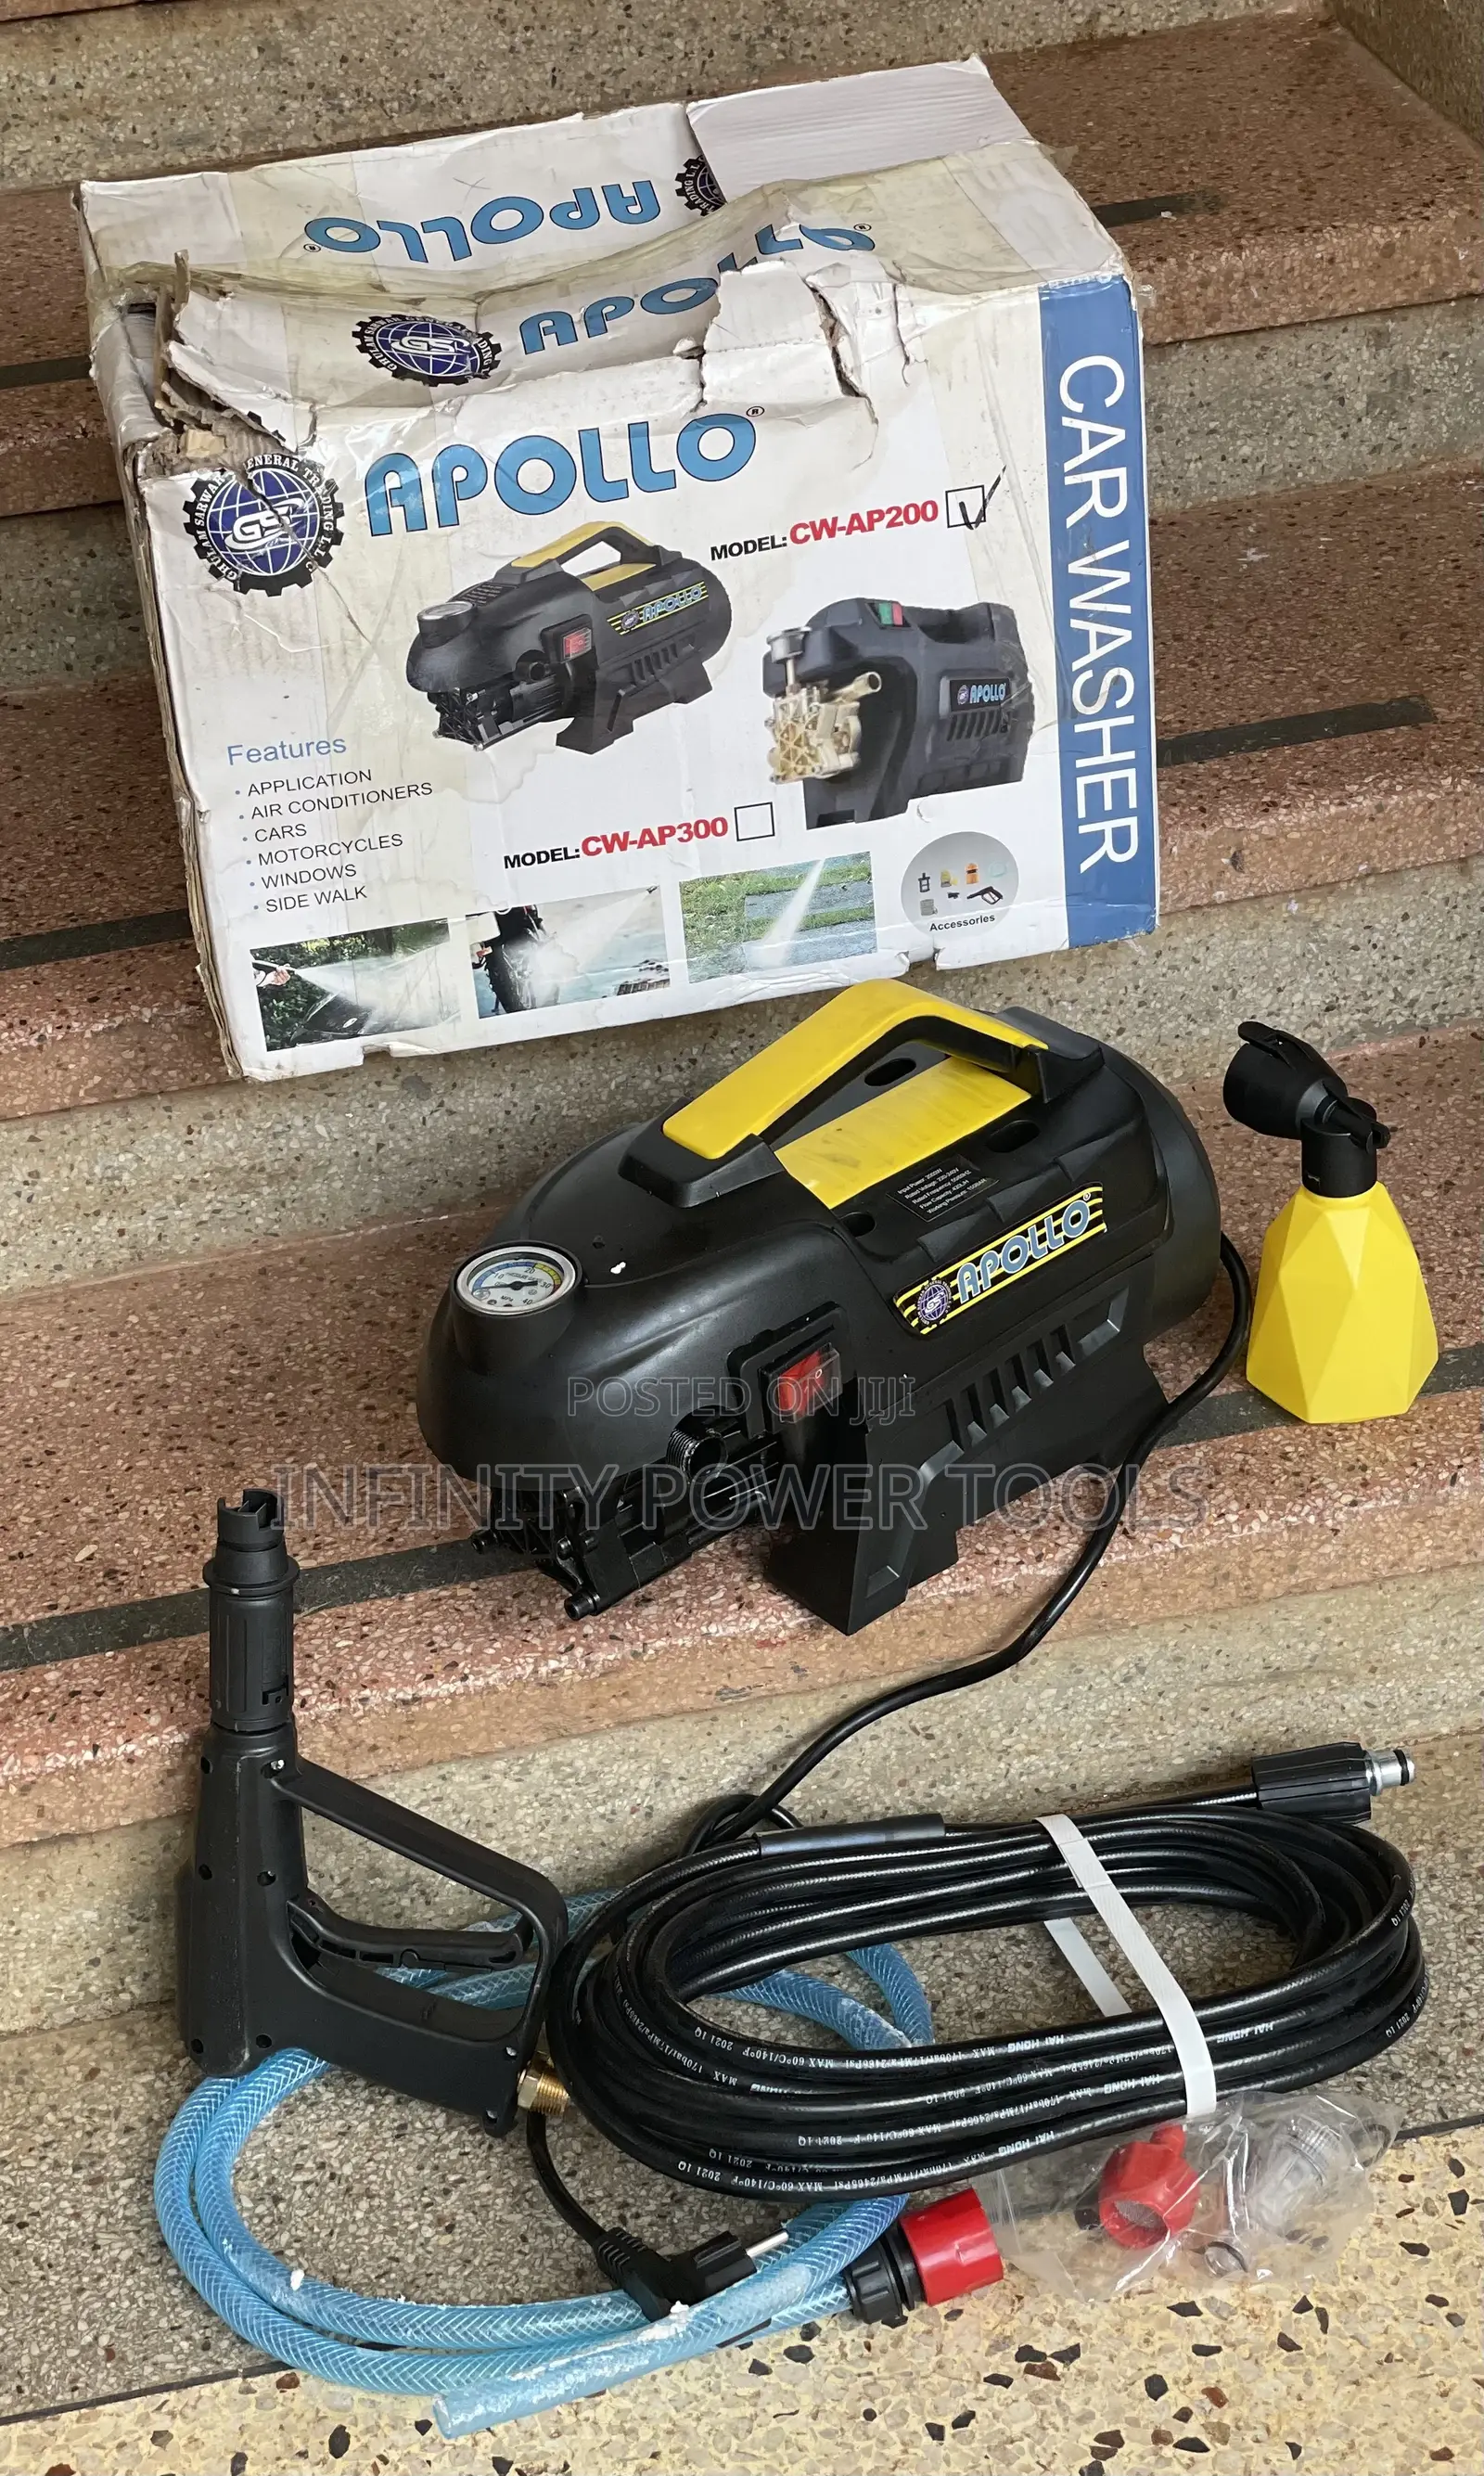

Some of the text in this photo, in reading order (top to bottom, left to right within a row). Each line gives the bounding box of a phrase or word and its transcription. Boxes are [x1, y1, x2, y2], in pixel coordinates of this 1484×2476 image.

[304, 180, 661, 263] APOLLO
[246, 454, 299, 472] ENERAL
[365, 413, 757, 537] APOLLO
[194, 475, 225, 526] SARWAR
[710, 500, 939, 561] MODEL: CW-AP200
[196, 530, 237, 582] GHULAM
[1058, 354, 1139, 873] CAR WASHER
[969, 683, 1006, 704] APOLLO
[227, 737, 347, 765] Features
[247, 769, 373, 797] APPLICATION
[251, 782, 433, 820] AIR CONDITIONERS
[254, 823, 307, 842] CARS
[504, 817, 728, 869] MODEL: CW-AP300
[259, 833, 403, 867] MOTORCYCLES
[262, 864, 357, 890] WINDOWS
[265, 886, 367, 913] SIDE WALK
[928, 914, 996, 932] Accessories
[956, 1200, 1091, 1304] APOLLO
[710, 2034, 734, 2051] 2021
[808, 2057, 835, 2069] MAX
[712, 2070, 738, 2086] MAX
[696, 2166, 721, 2182] 2021
[798, 2181, 824, 2192] MAX
